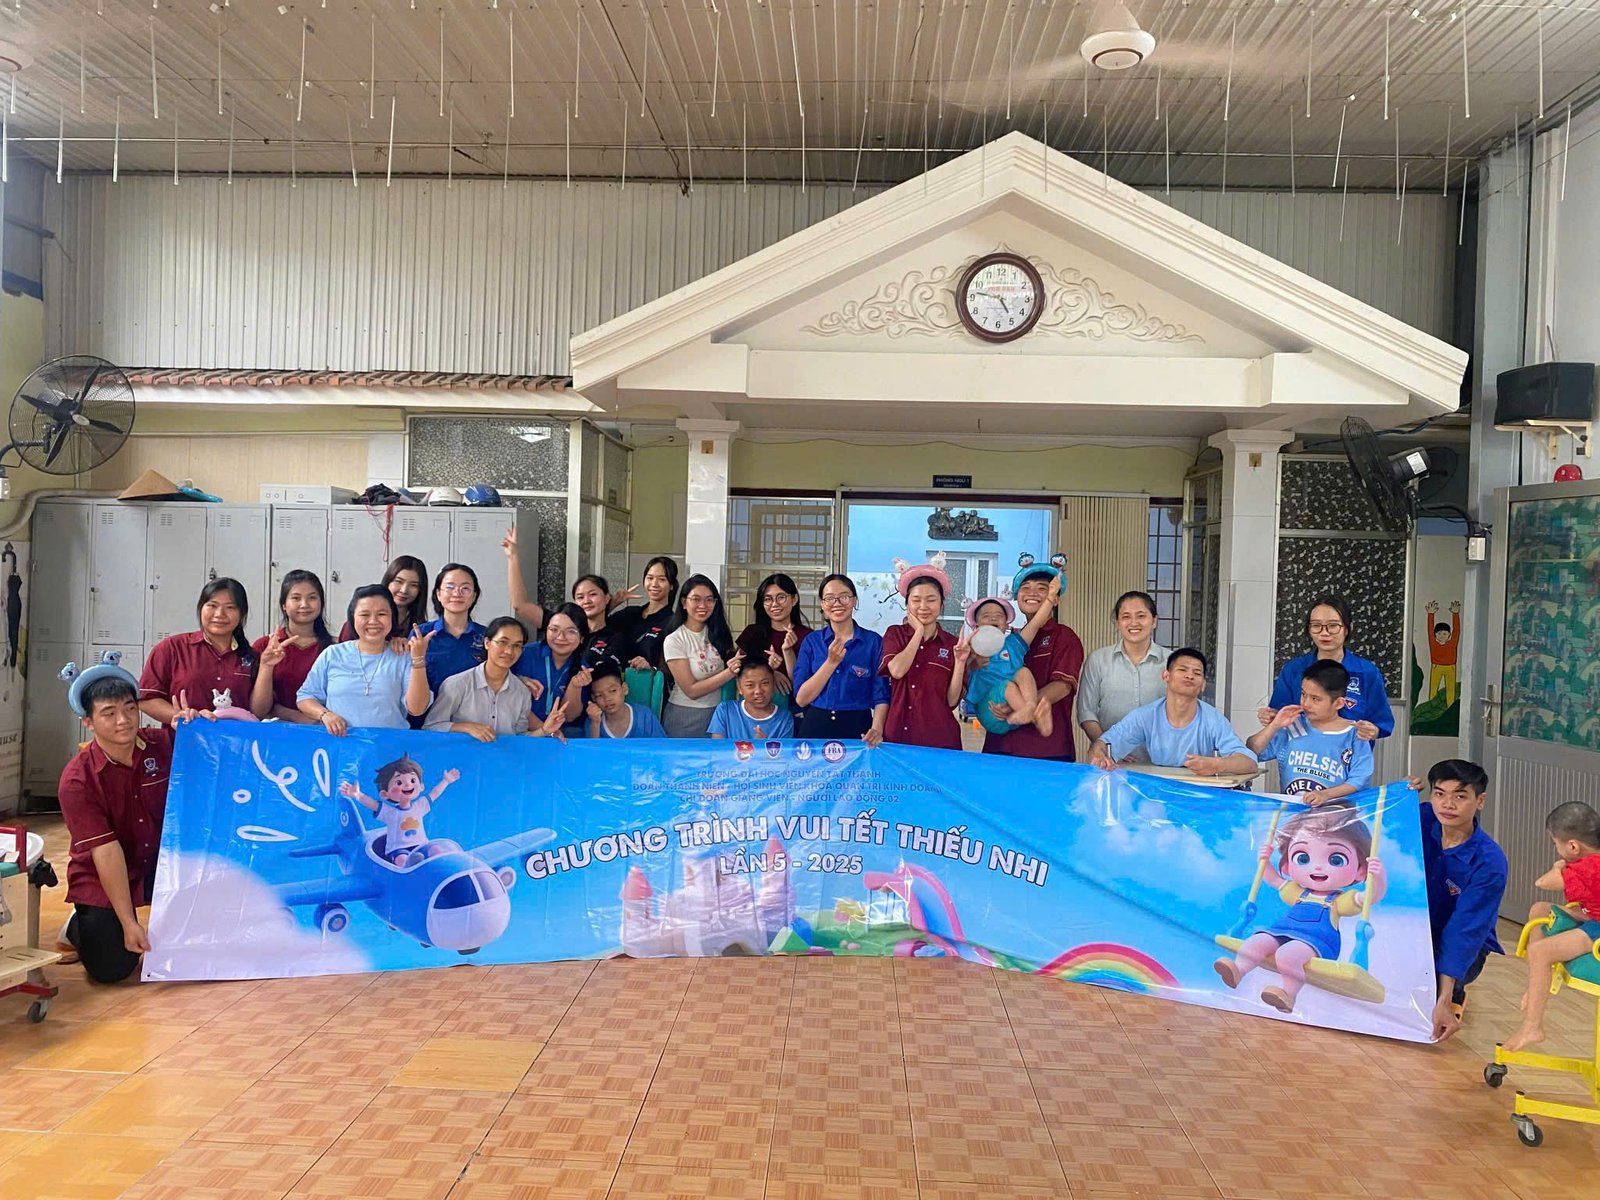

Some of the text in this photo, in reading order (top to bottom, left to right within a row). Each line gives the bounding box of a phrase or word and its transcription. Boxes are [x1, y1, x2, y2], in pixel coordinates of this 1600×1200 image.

[986, 271, 992, 279] 11
[997, 268, 1006, 276] 12
[1012, 271, 1017, 280] 1
[975, 281, 984, 289] 10
[1021, 282, 1027, 290] 2
[969, 293, 976, 302] 9
[1024, 295, 1030, 303] 3
[972, 307, 979, 315] 8
[1019, 308, 1025, 316] 4
[982, 316, 988, 325] 7
[995, 320, 1001, 329] 6
[1009, 317, 1015, 326] 5
[1288, 750, 1344, 779] CHELSEA
[883, 783, 907, 791] KINH
[1286, 780, 1324, 795] CHELS
[888, 795, 900, 803] 02
[525, 808, 1049, 887] CHƯƠNG TRÌNH VUI TẾT THIẾU NHI
[719, 847, 768, 875] LẦN
[772, 851, 788, 873] 5
[807, 852, 864, 875] 2025
